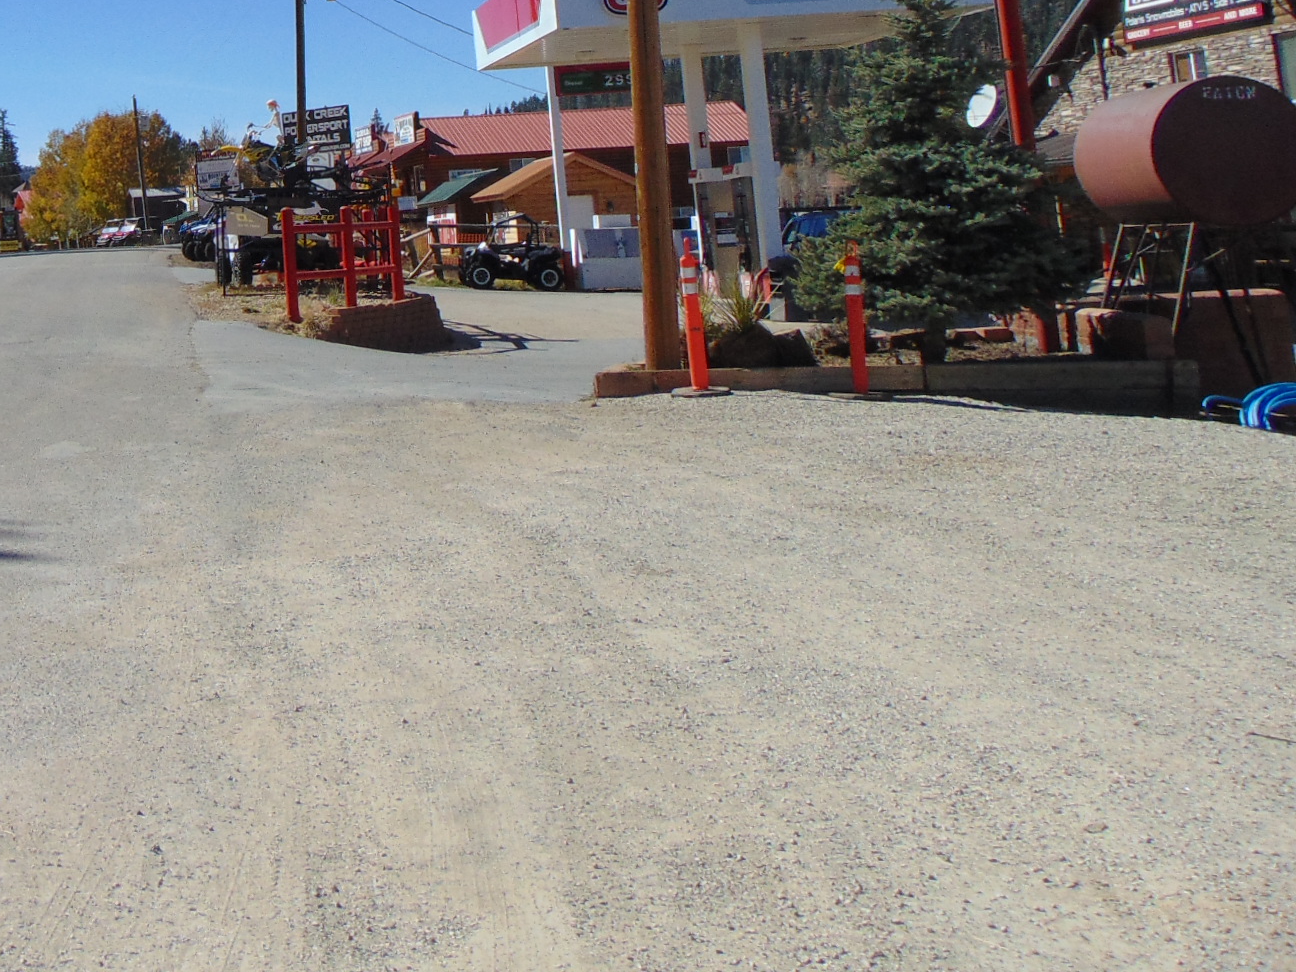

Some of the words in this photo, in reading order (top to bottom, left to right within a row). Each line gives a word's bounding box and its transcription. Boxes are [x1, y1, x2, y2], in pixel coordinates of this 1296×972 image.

[1124, 14, 1145, 27] Polaris
[1145, 6, 1185, 22] Snowmobiles
[283, 111, 311, 124] DUK
[313, 106, 348, 120] CREEK
[284, 119, 349, 137] POERSPORT
